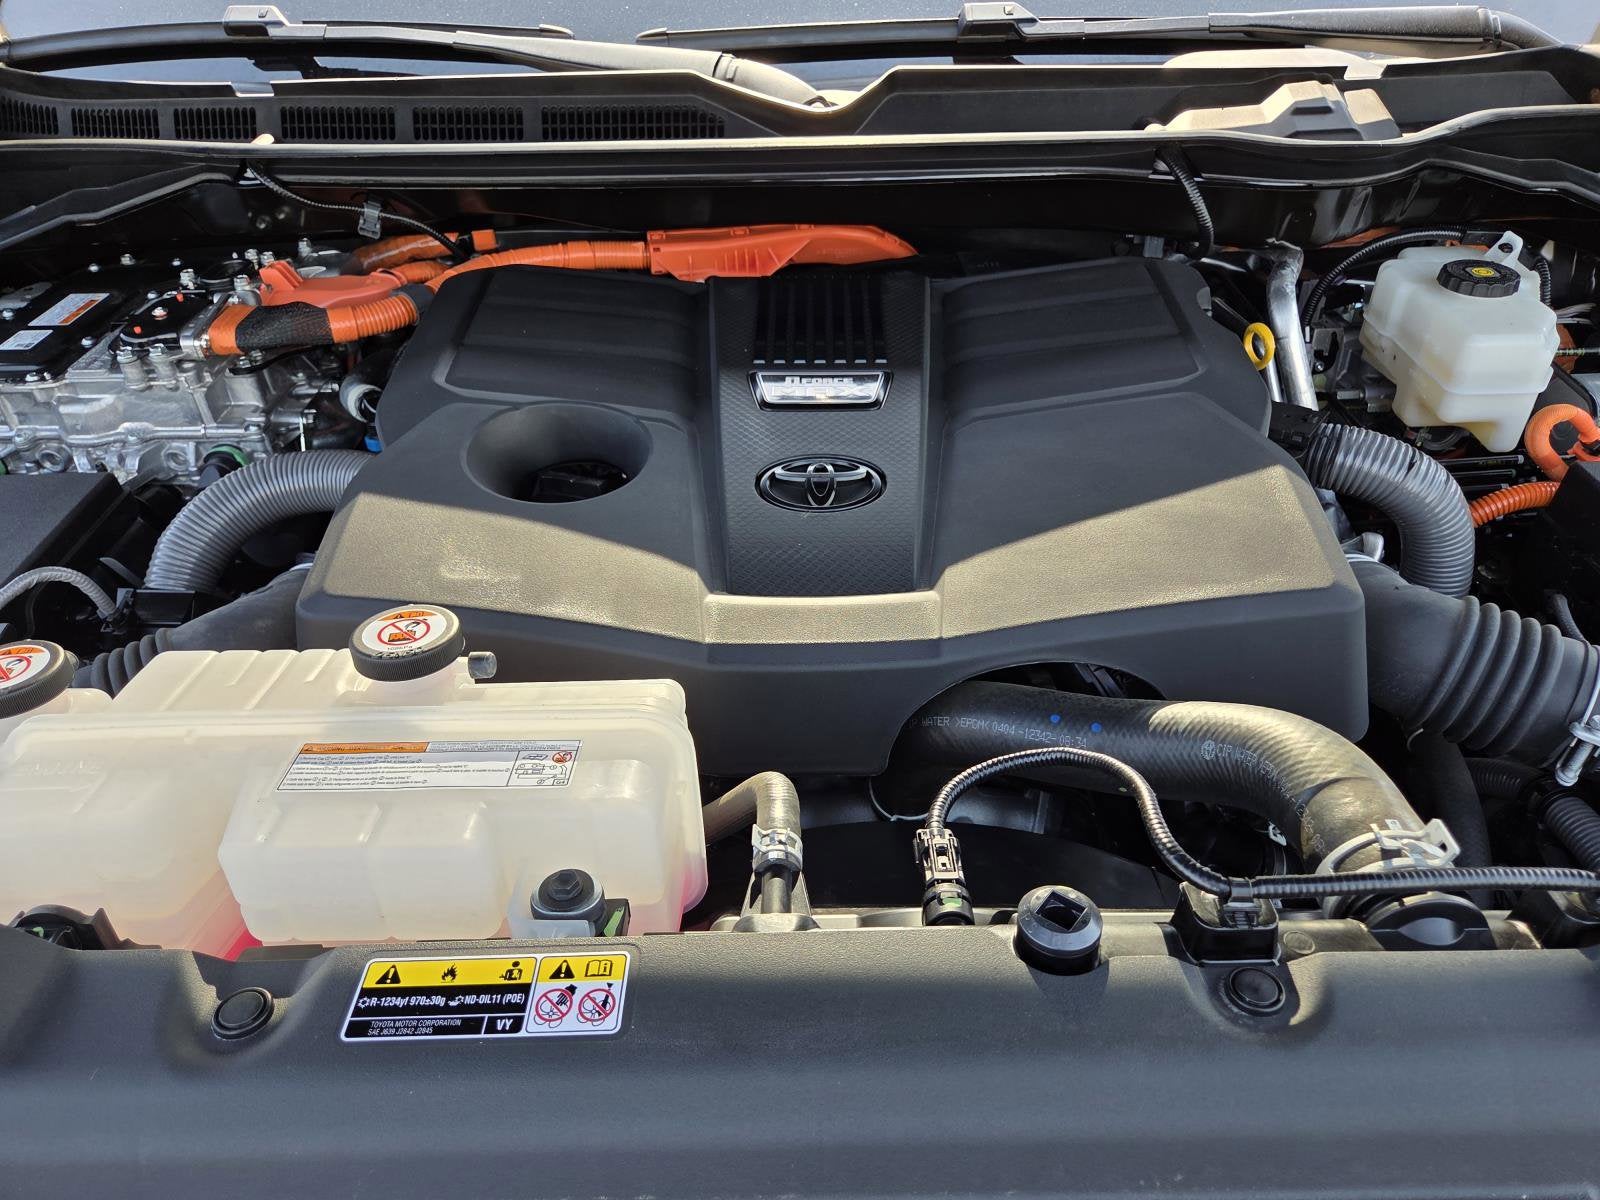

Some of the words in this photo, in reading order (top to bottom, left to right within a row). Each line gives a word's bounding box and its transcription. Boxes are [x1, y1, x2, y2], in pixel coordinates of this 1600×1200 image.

[921, 716, 950, 728] WATER
[369, 996, 409, 1008] R-1234yf
[409, 995, 446, 1007] 970±30g
[464, 994, 502, 1005] ND-OIL11
[502, 993, 525, 1005] (POE)
[371, 1020, 394, 1029] TOYOTA
[394, 1020, 417, 1028] MOTOR
[418, 1019, 462, 1027] CORPORATION
[496, 1018, 514, 1031] VY
[367, 1028, 380, 1036] SAE
[380, 1028, 396, 1036] J639
[396, 1027, 415, 1035] J2842
[415, 1026, 434, 1035] J2845
